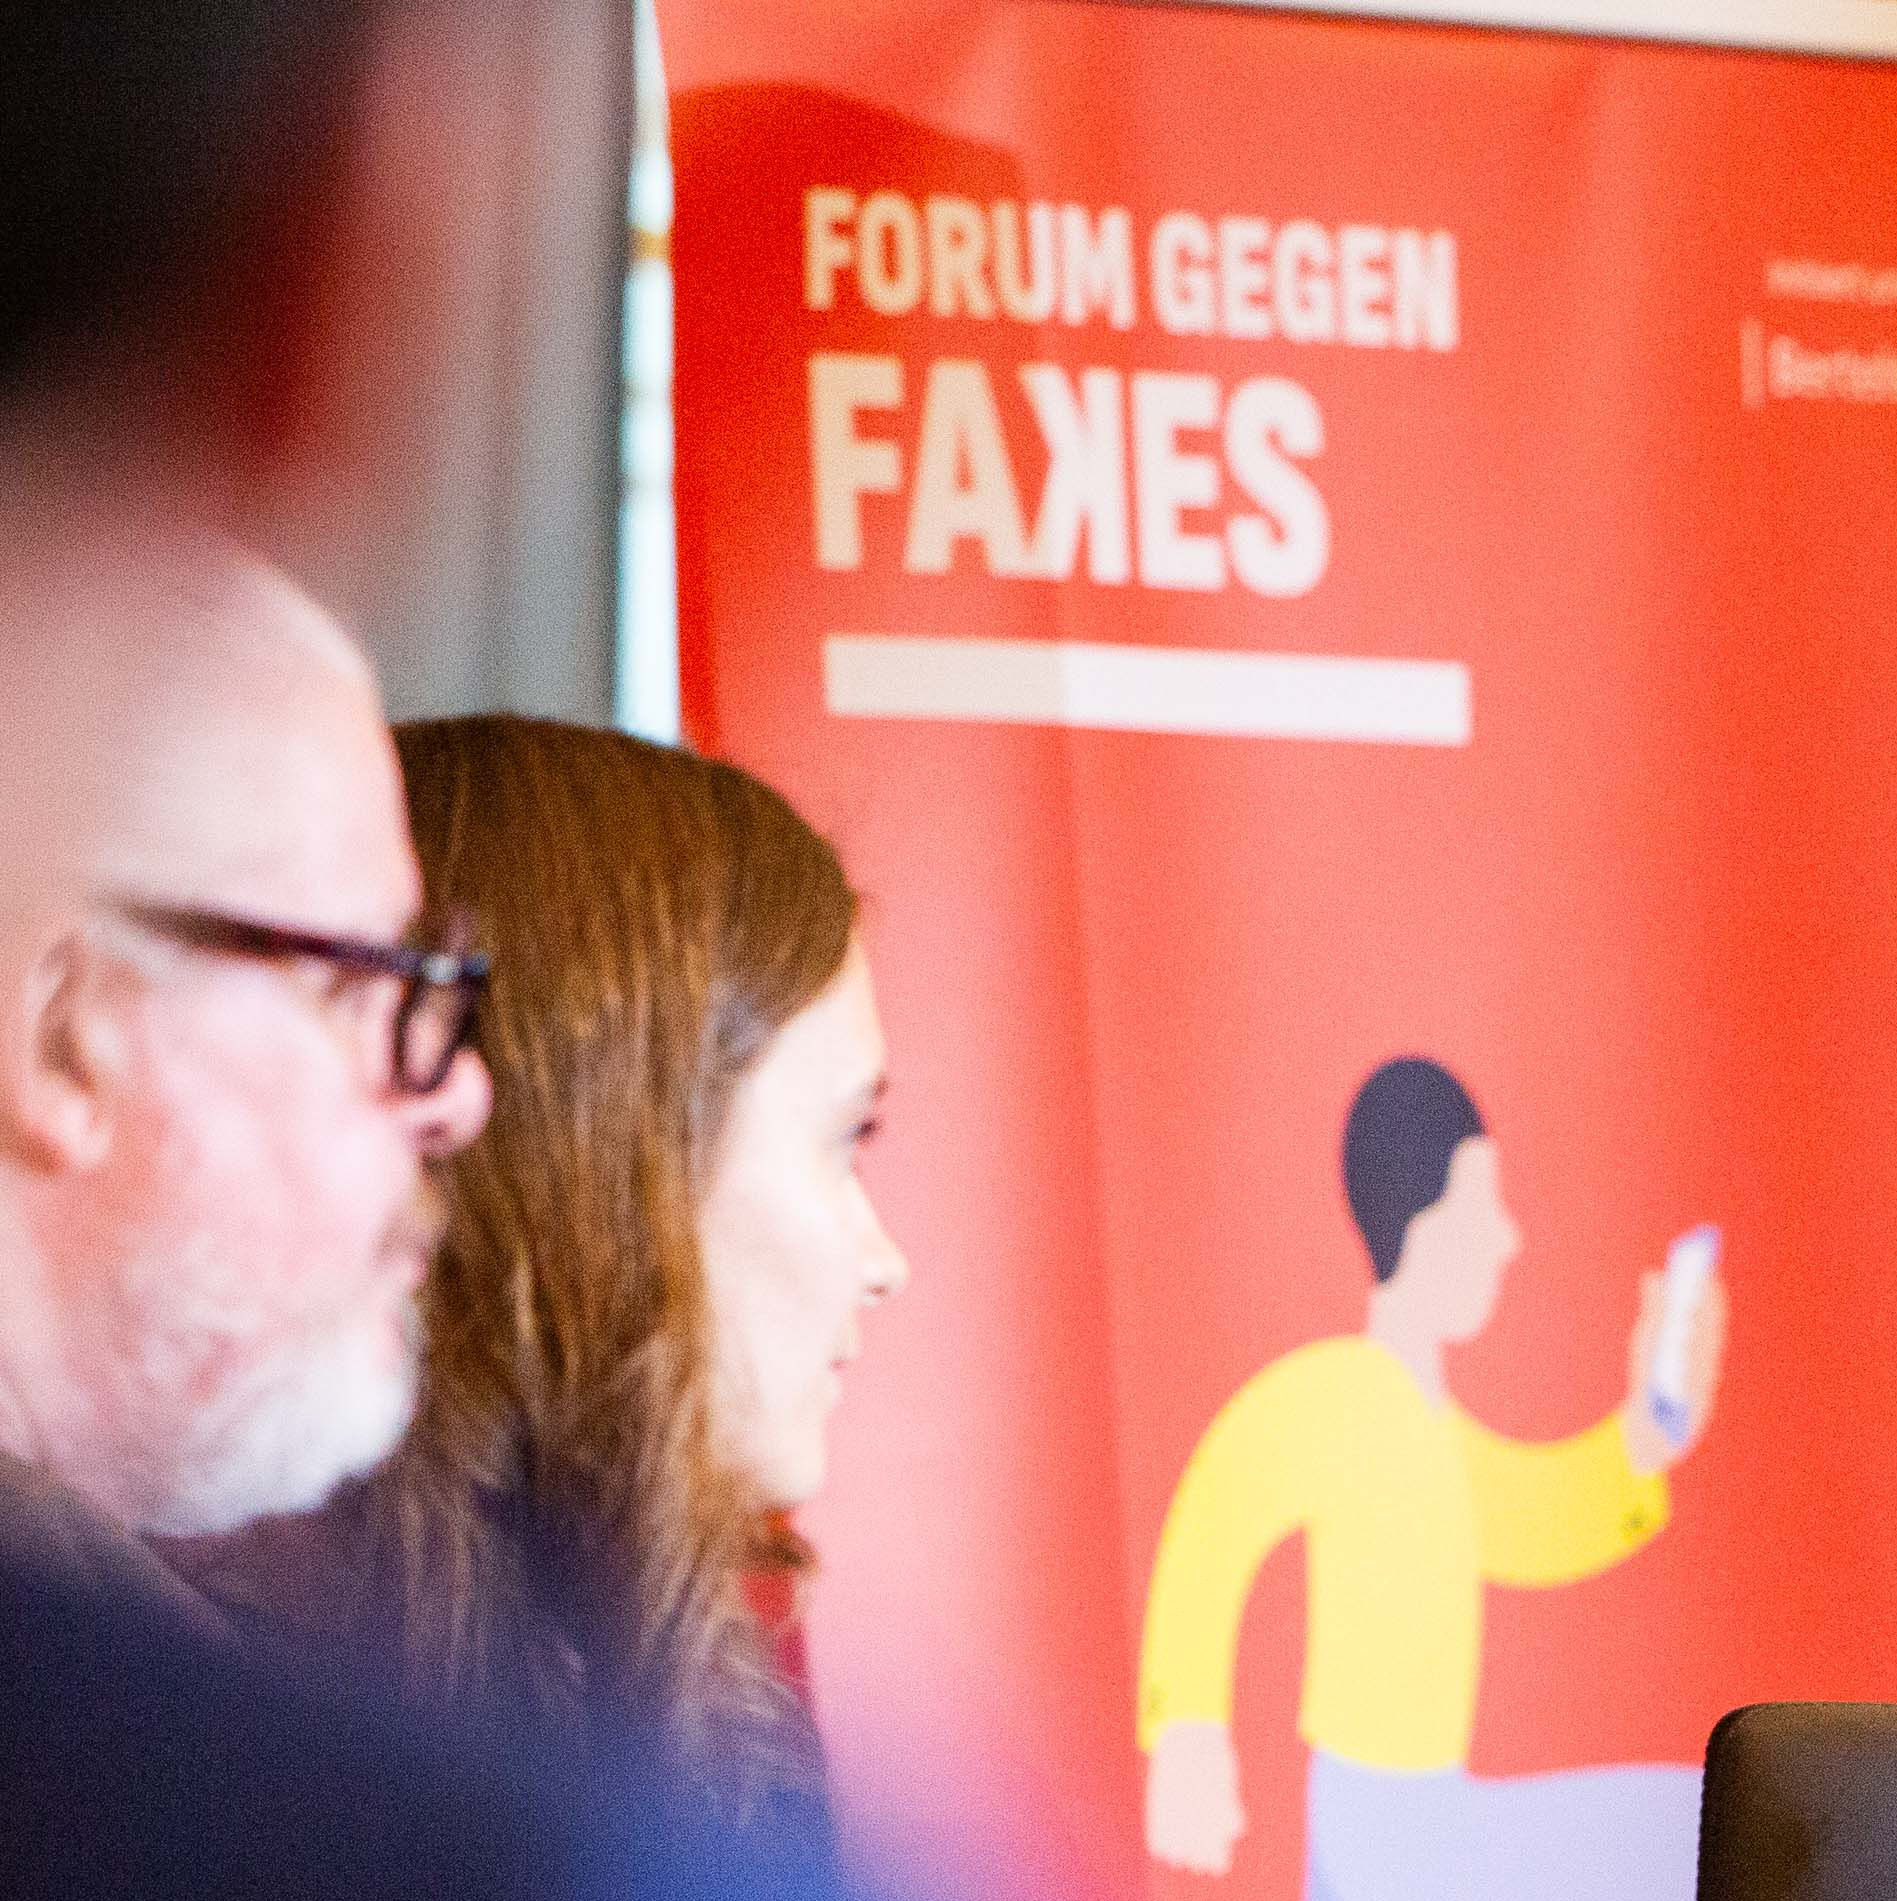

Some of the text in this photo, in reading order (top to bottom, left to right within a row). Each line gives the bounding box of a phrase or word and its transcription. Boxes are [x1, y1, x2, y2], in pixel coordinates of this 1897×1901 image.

[804, 187, 1462, 352] FORUM GEGEN
[806, 351, 1329, 600] FAKES
